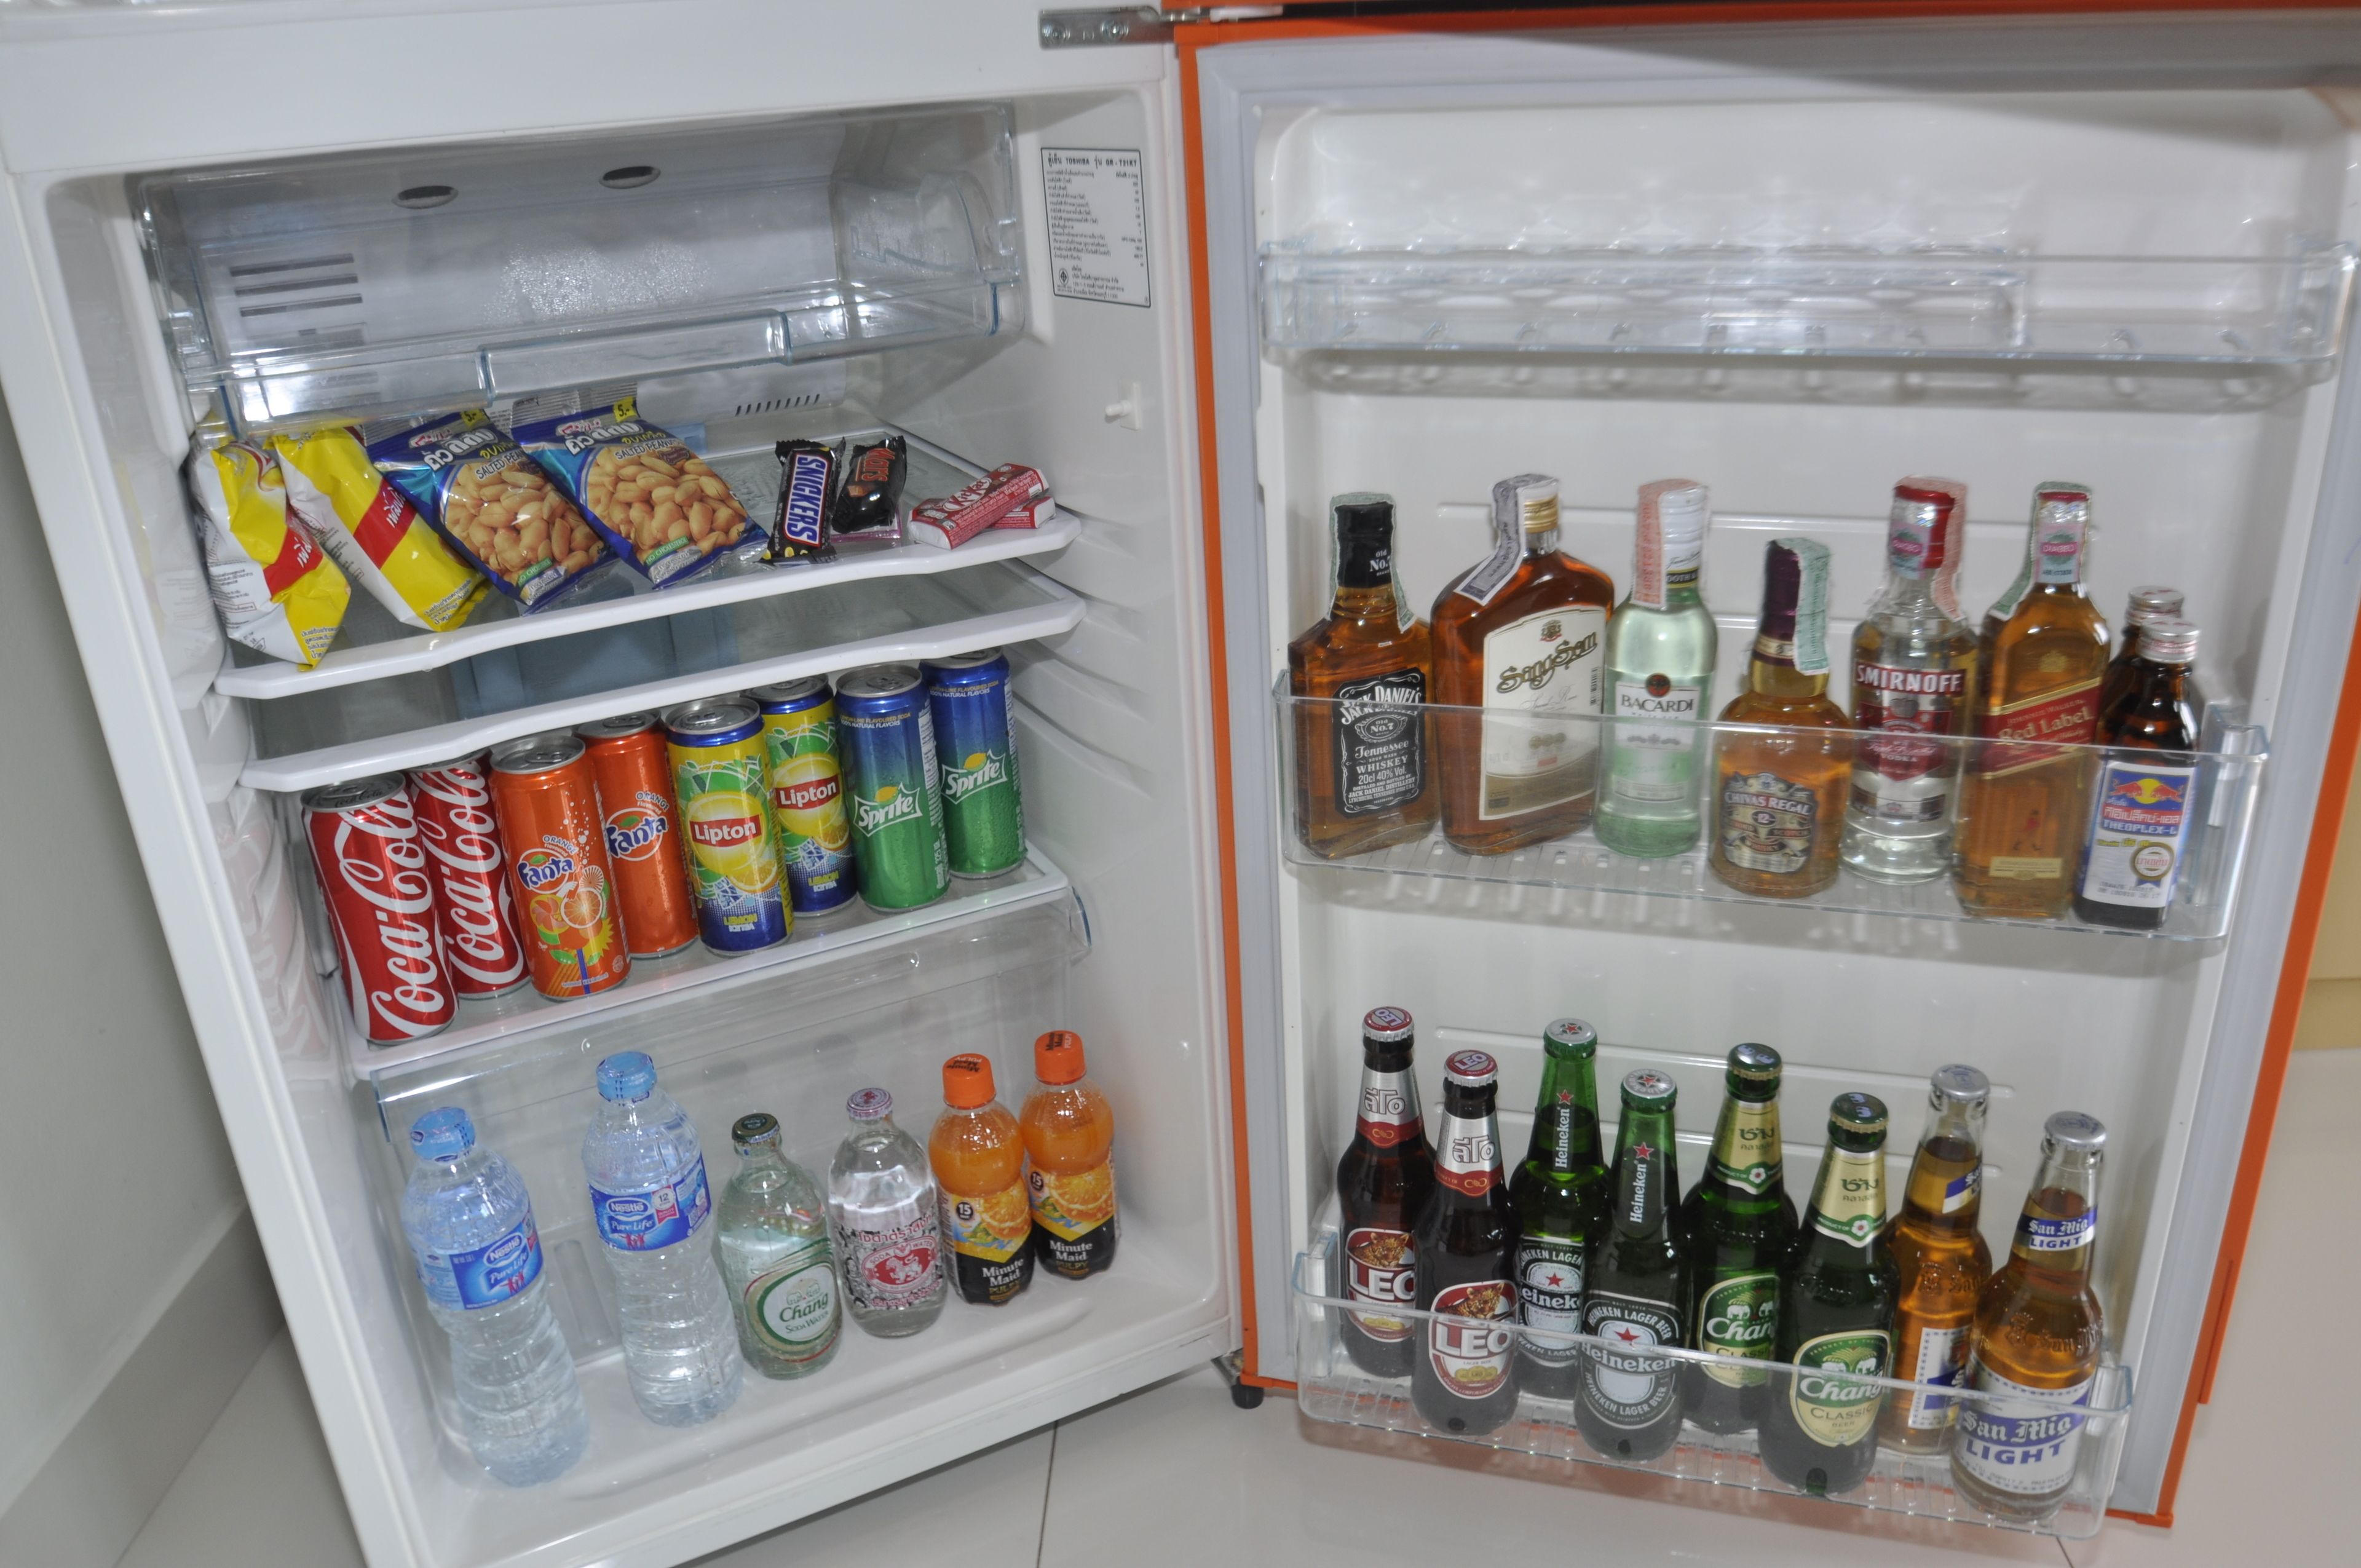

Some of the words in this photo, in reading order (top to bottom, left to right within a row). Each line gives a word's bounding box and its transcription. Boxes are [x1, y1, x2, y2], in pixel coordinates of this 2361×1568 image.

[615, 446, 646, 460] SALTED
[476, 457, 505, 480] SALTED
[786, 455, 828, 545] SNICKERS
[1857, 665, 1961, 693] SMIRNOFF
[967, 687, 991, 697] FLAVORS
[1621, 694, 1695, 713] BACARDI
[876, 720, 901, 729] FLAVORS
[1370, 723, 1394, 734] No.7
[1355, 740, 1409, 759] Tennessee
[1356, 755, 1408, 774] WHISKEY
[946, 759, 1001, 798] Sprite
[1353, 782, 1376, 791] DISTILLED
[1386, 776, 1405, 785] BOTTLED
[1358, 774, 1375, 785] 20cl
[1377, 769, 1394, 780] 40%
[1394, 766, 1407, 777] Vol.
[1364, 786, 1385, 795] DANIEL
[1385, 777, 1415, 790] DISTILLERY
[636, 791, 670, 813] ORANGE
[779, 780, 837, 807] Lipton
[1724, 791, 1766, 807] CHIVAS
[1768, 797, 1811, 815] REGAL
[859, 792, 915, 830] Sprite
[1757, 813, 1770, 823] 12
[606, 816, 668, 858] Fanta
[693, 820, 757, 845] Lipton
[543, 834, 579, 855] ORANGE
[517, 857, 575, 890] Fanta
[1374, 1009, 1403, 1028] LEO
[1453, 1053, 1487, 1071] LEO
[1555, 1108, 1570, 1168] Heineken
[658, 1192, 670, 1203] 12
[1629, 1163, 1647, 1224] Heineken
[958, 1203, 972, 1215] 15
[611, 1221, 632, 1230] Pure
[633, 1219, 654, 1231] Life
[2029, 1220, 2055, 1236] San
[2057, 1218, 2089, 1236] Mig
[1050, 1240, 1093, 1253] Minute
[2030, 1235, 2083, 1249] LIGHT
[869, 1251, 891, 1265] SODA
[1056, 1251, 1088, 1262] Maid
[489, 1267, 512, 1284] Pure
[512, 1251, 528, 1272] Life
[983, 1259, 1024, 1277] Minute
[990, 1269, 1021, 1286] Maid
[780, 1293, 829, 1323] Chang
[1522, 1288, 1580, 1310] einek
[1587, 1306, 1621, 1326] HEINEKEN
[1624, 1310, 1658, 1326] LAGER
[1655, 1320, 1672, 1340] BEER
[1706, 1317, 1776, 1341] Chan
[1435, 1323, 1513, 1358] LEO
[1581, 1342, 1677, 1372] Heineken
[1584, 1371, 1618, 1412] HEINEKEN
[1619, 1404, 1650, 1416] LAGER
[1650, 1387, 1667, 1407] BEER
[1800, 1376, 1883, 1402] Chang
[1809, 1403, 1874, 1420] CLASSIC
[1963, 1410, 2007, 1442] San
[2010, 1415, 2072, 1444] Mig
[1966, 1439, 2066, 1465] LIGHT
